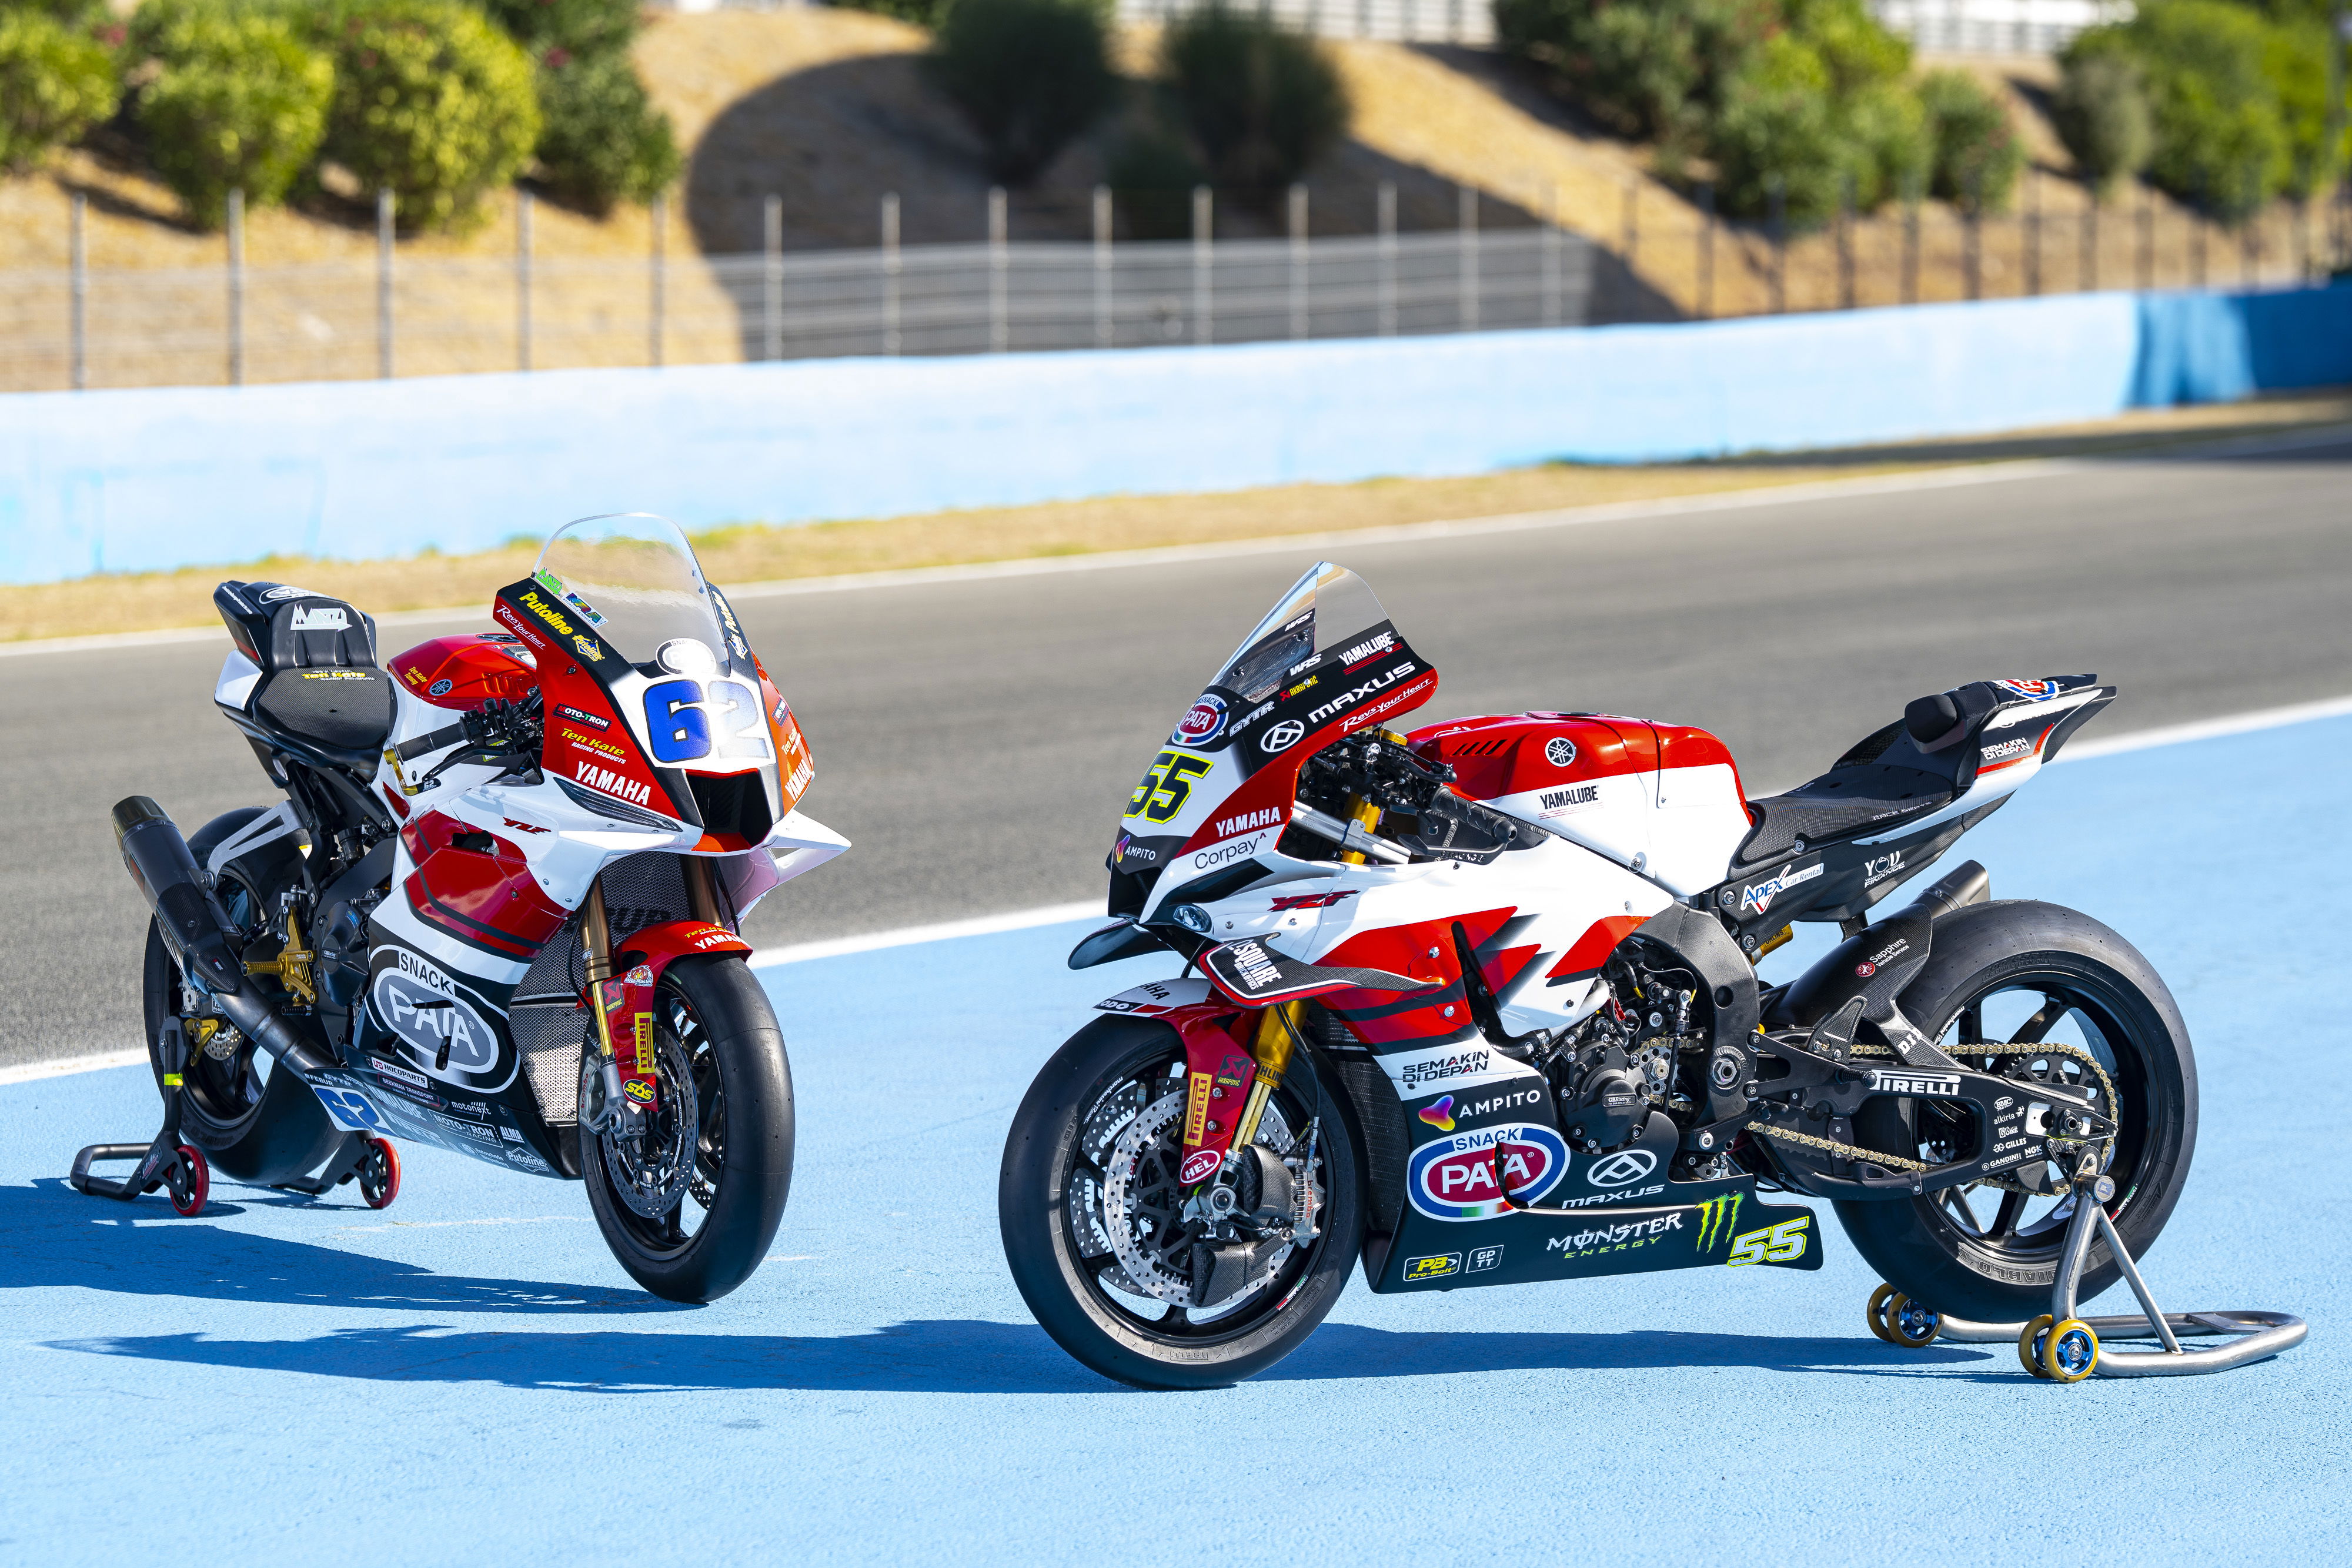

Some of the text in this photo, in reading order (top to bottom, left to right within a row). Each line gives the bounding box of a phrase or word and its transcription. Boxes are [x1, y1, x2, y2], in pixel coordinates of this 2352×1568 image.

[519, 591, 574, 636] Putoline
[566, 593, 602, 624] MRA
[1339, 631, 1395, 666] YAMALUBE
[409, 666, 428, 683] Ten Kate
[1289, 653, 1322, 676] WRS
[1200, 696, 1218, 707] SNACK
[1308, 661, 1415, 724] MAXUS
[558, 706, 609, 727] MOTO-TRON
[579, 719, 606, 730] RACING
[643, 678, 770, 764] 62
[1184, 710, 1211, 730] PATA
[1230, 701, 1275, 737] GYTR
[560, 728, 625, 757] Ten Kate
[571, 741, 627, 764] RACING PRODUCTS
[1980, 737, 2028, 754] SEMAKIN
[1996, 743, 2030, 757] DEPAN
[575, 761, 652, 805] YAMAHA
[1123, 750, 1214, 824] 55
[1540, 785, 1599, 810] YAMALUBE
[1216, 807, 1281, 837] YAMAHA
[1125, 845, 1156, 861] AMPITO
[1786, 865, 1822, 887] Car Rental
[1743, 872, 1786, 909] APEX
[684, 928, 706, 938] Ten
[1870, 938, 1906, 964] Sapphire
[1876, 945, 1910, 967] Vehicle Service
[400, 953, 453, 995] SNACK
[389, 984, 479, 1057] PATA
[639, 1017, 653, 1068] PIRELLI
[310, 1074, 335, 1087] FEBUR
[384, 1064, 426, 1084] HOCOPARTS
[1422, 1060, 1489, 1081] DEPAN
[382, 1077, 435, 1101] BEEKMAN TRANSPORT
[624, 1082, 654, 1101] sbs
[1869, 1069, 1961, 1096] PIRELLI
[314, 1088, 403, 1138] 62
[452, 1101, 491, 1120] motonext
[1187, 1077, 1208, 1141] PIRELLI
[1459, 1089, 1541, 1118] AMPITO
[1996, 1099, 2012, 1108] BMC
[433, 1114, 495, 1138] MOTO-TRON
[1994, 1113, 2016, 1125] alkiria
[466, 1131, 497, 1144] RACING
[500, 1126, 523, 1141] ALMA
[1455, 1128, 1521, 1151] SNACK
[2005, 1138, 2027, 1149] GILLES
[508, 1151, 547, 1168] Putoline
[1990, 1153, 2019, 1167] GANDINI
[2024, 1145, 2043, 1156] NGK
[1185, 1159, 1214, 1180] HEL
[1562, 1184, 1665, 1209] MAXUS
[2111, 1186, 2138, 1222] FORGED ALUMINIUM
[1546, 1211, 1684, 1252] MONSTER
[1726, 1215, 1810, 1268] 55
[1477, 1249, 1496, 1260] GP
[1564, 1235, 1664, 1259] ENERGY
[1408, 1267, 1456, 1279] Pro-Bolt
[1416, 1256, 1449, 1272] PB
[1476, 1258, 1494, 1268] TT
[1278, 1276, 1309, 1311] FORGED ALUMINIUM
[1170, 1350, 1209, 1362] PIRELLI
